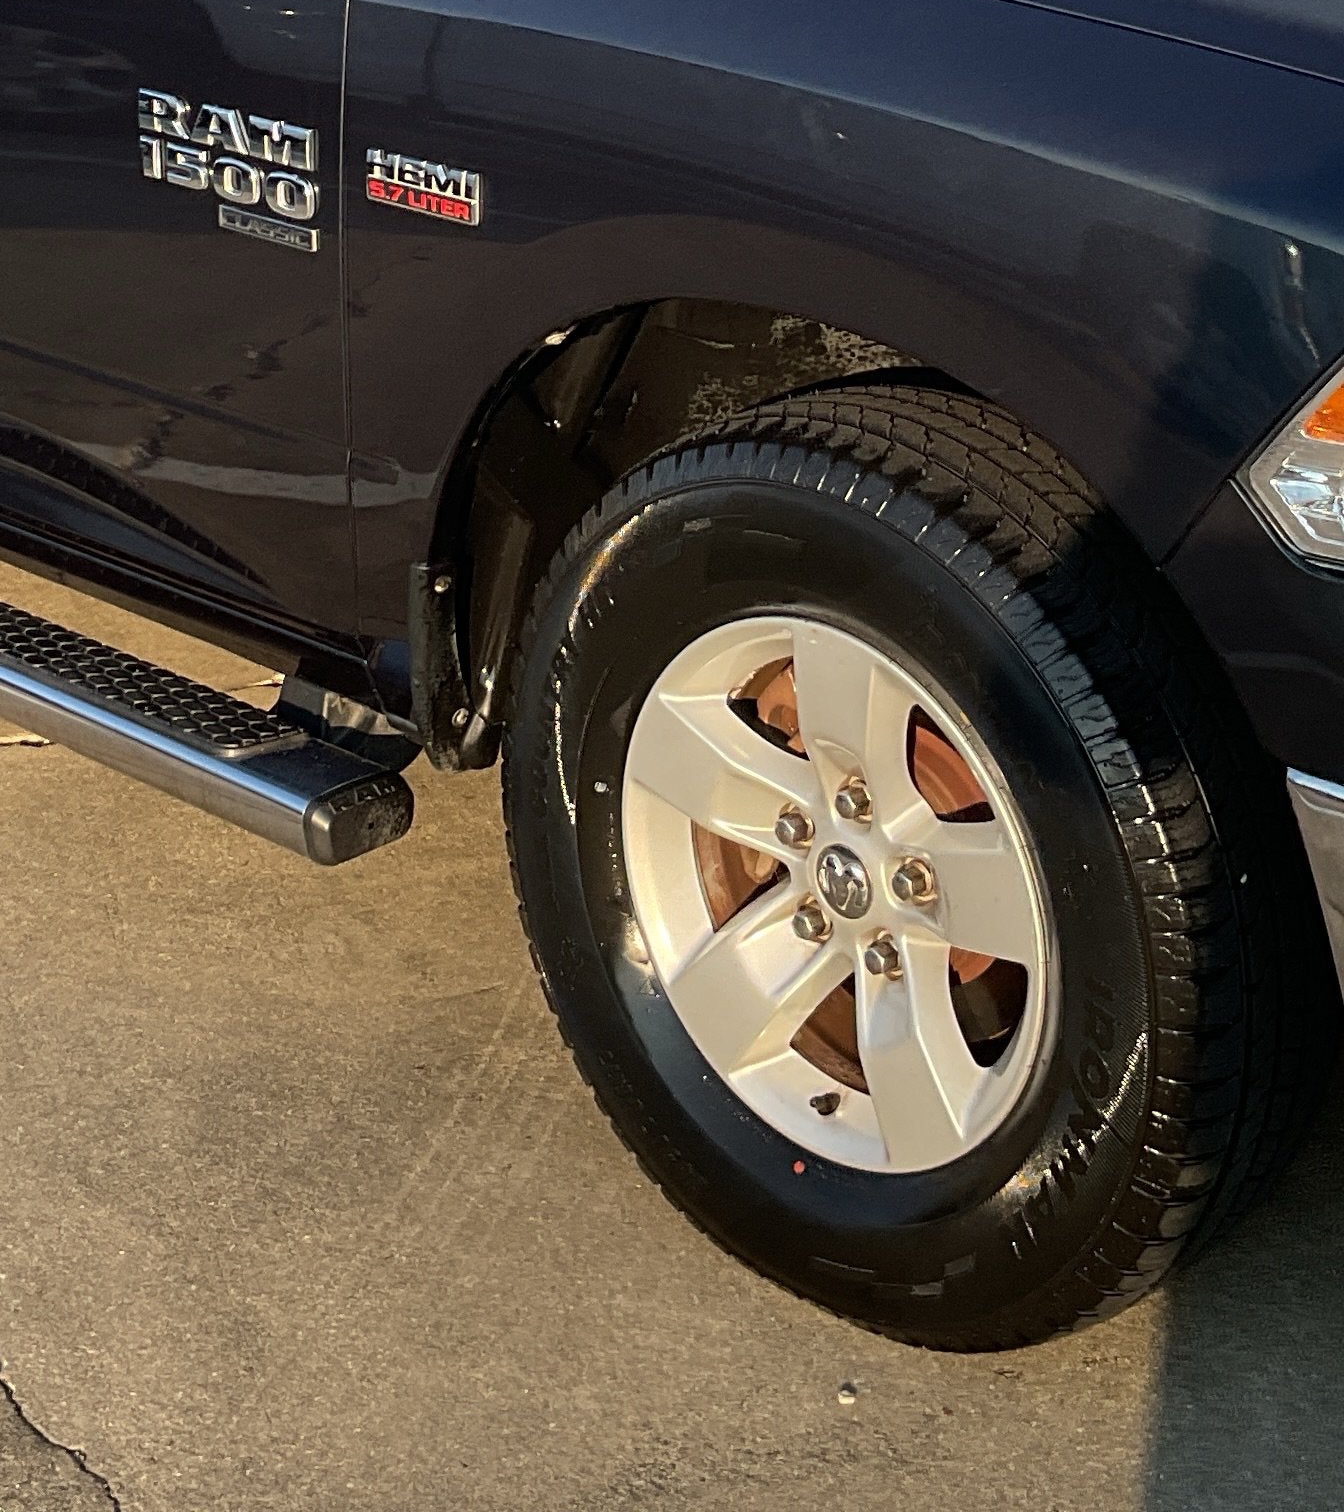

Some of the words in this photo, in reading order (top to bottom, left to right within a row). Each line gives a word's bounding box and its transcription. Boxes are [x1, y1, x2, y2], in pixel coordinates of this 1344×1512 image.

[138, 88, 319, 172] RAM
[140, 135, 319, 220] 1500
[366, 148, 482, 202] HEMI
[367, 180, 405, 202] 5.7
[406, 190, 471, 222] LITER
[222, 209, 312, 248] CLASSIC
